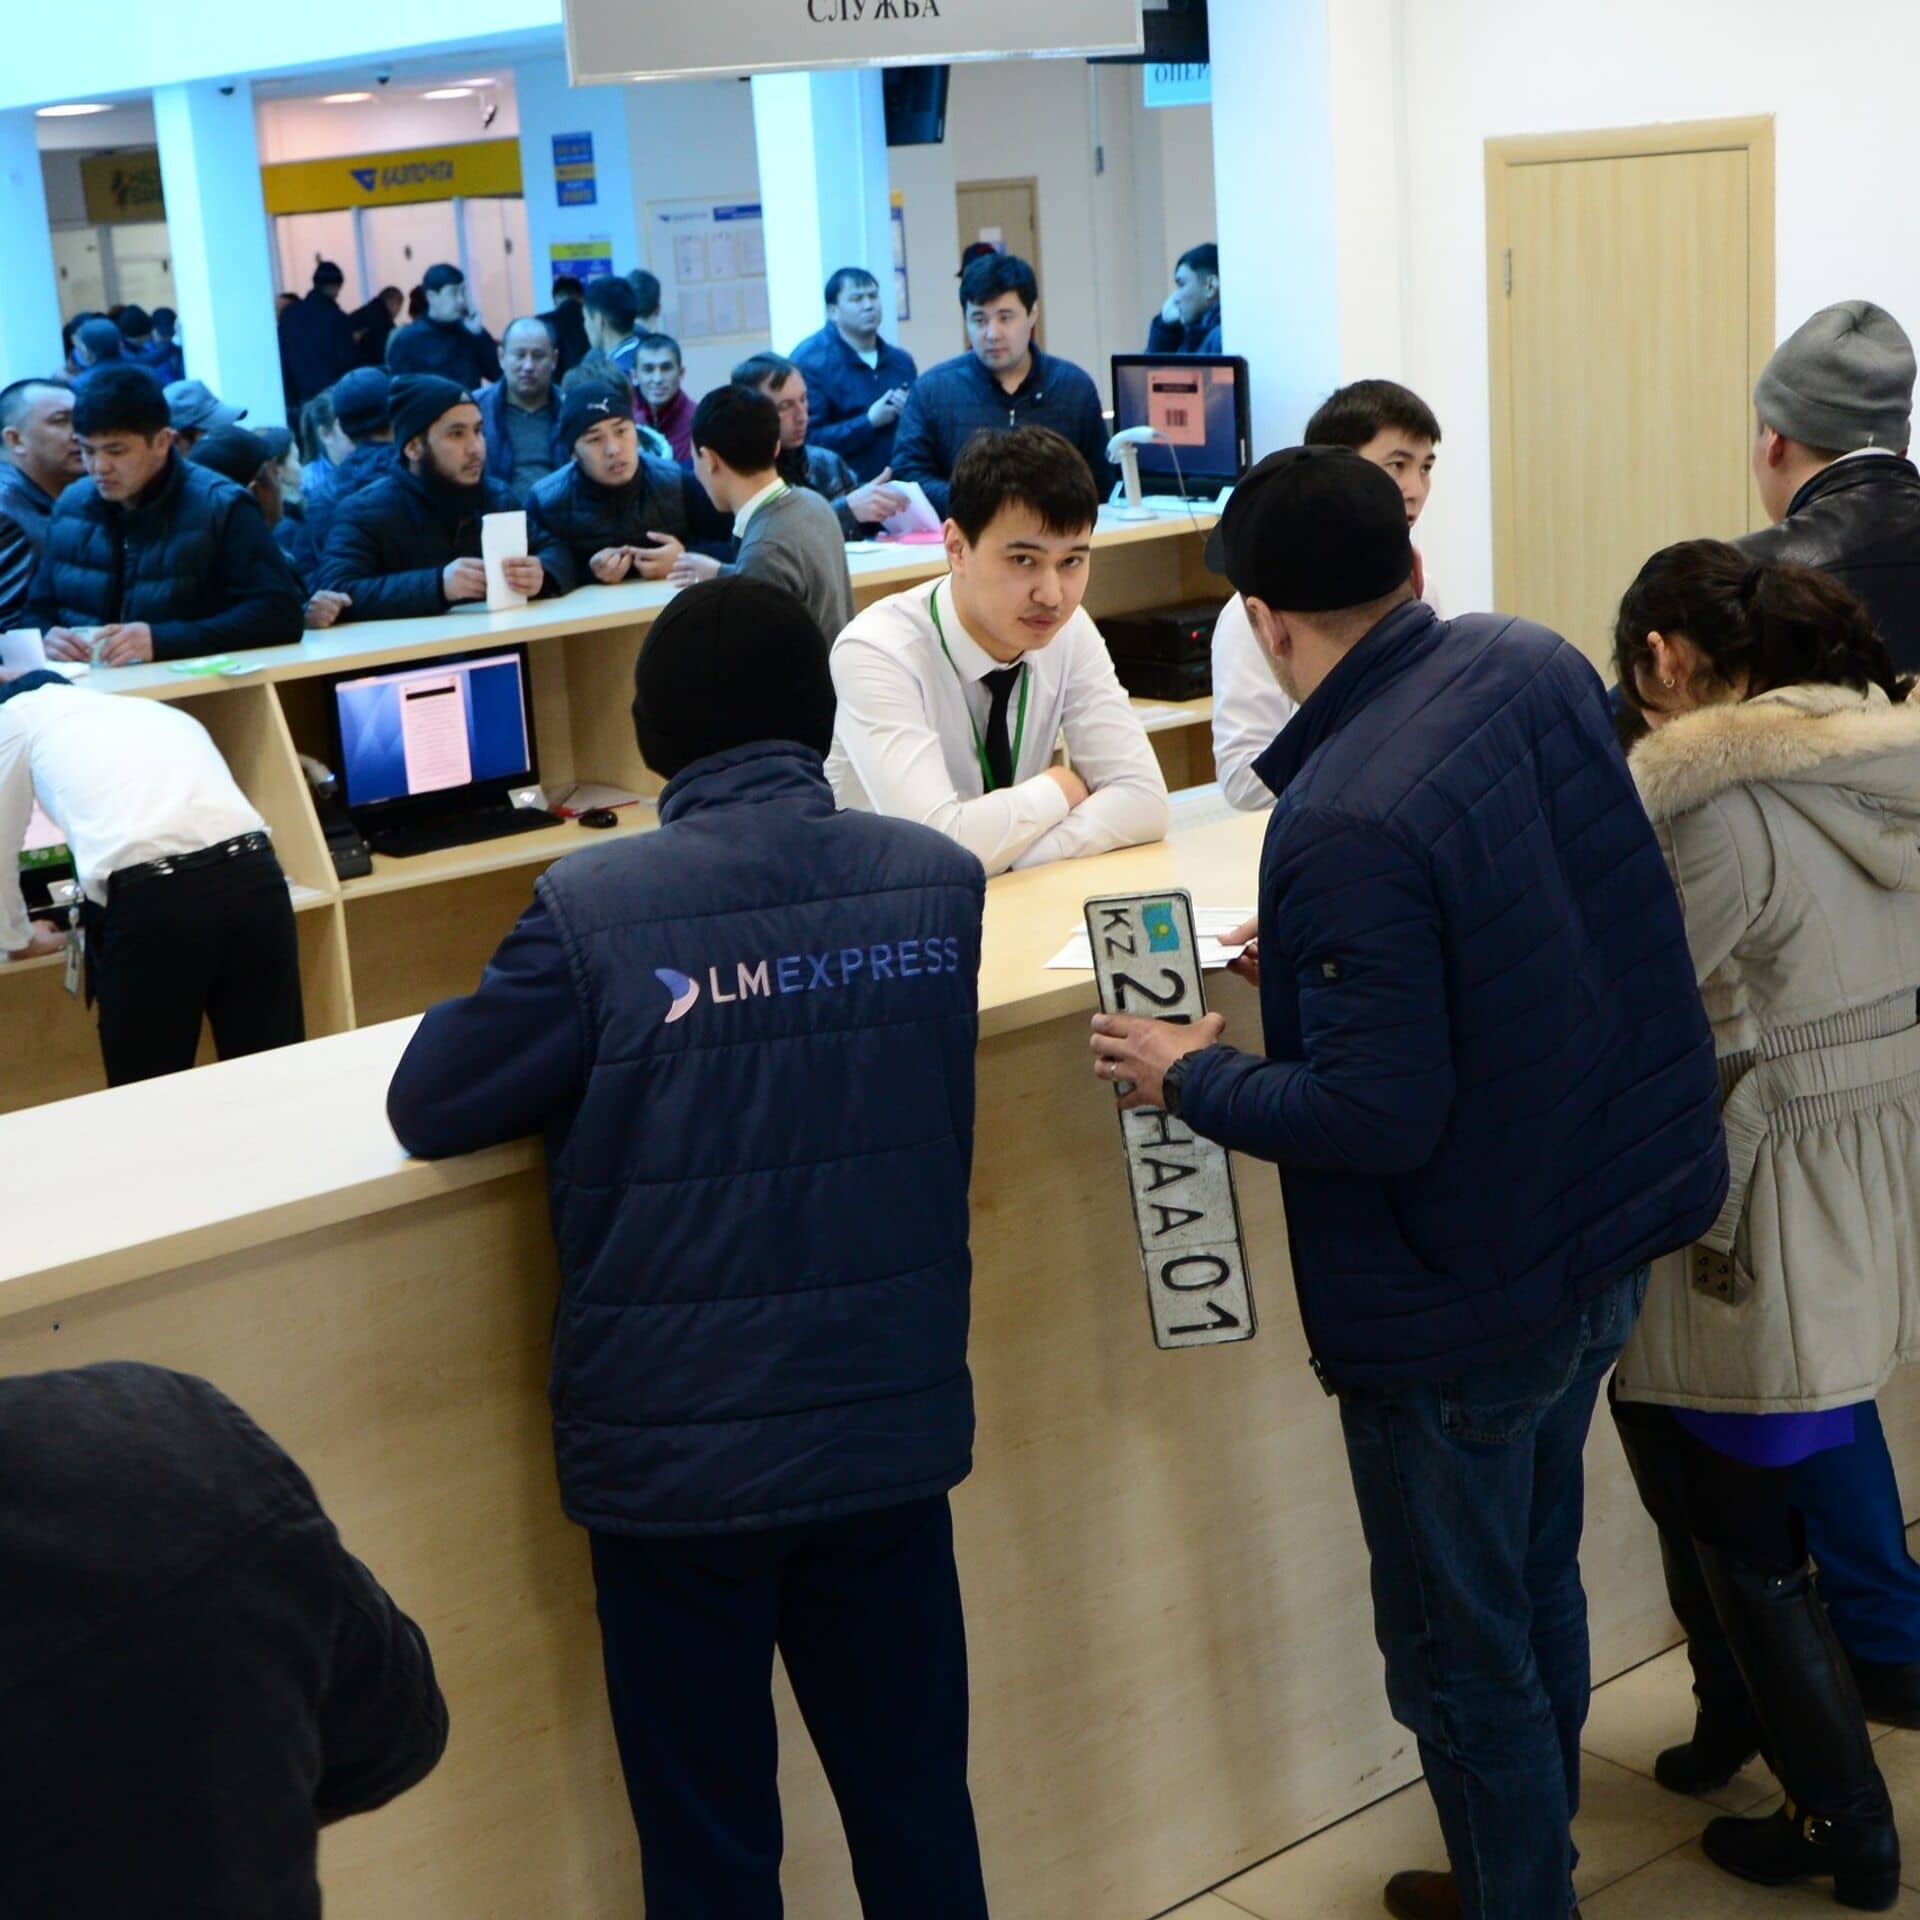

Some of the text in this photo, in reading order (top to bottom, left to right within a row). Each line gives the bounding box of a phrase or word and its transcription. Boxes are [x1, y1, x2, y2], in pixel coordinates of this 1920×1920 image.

[808, 0, 940, 22] СЛУЖБА
[1155, 64, 1211, 83] ОПЕР
[1100, 908, 1138, 960] KZ
[1160, 1254, 1240, 1336] 01
